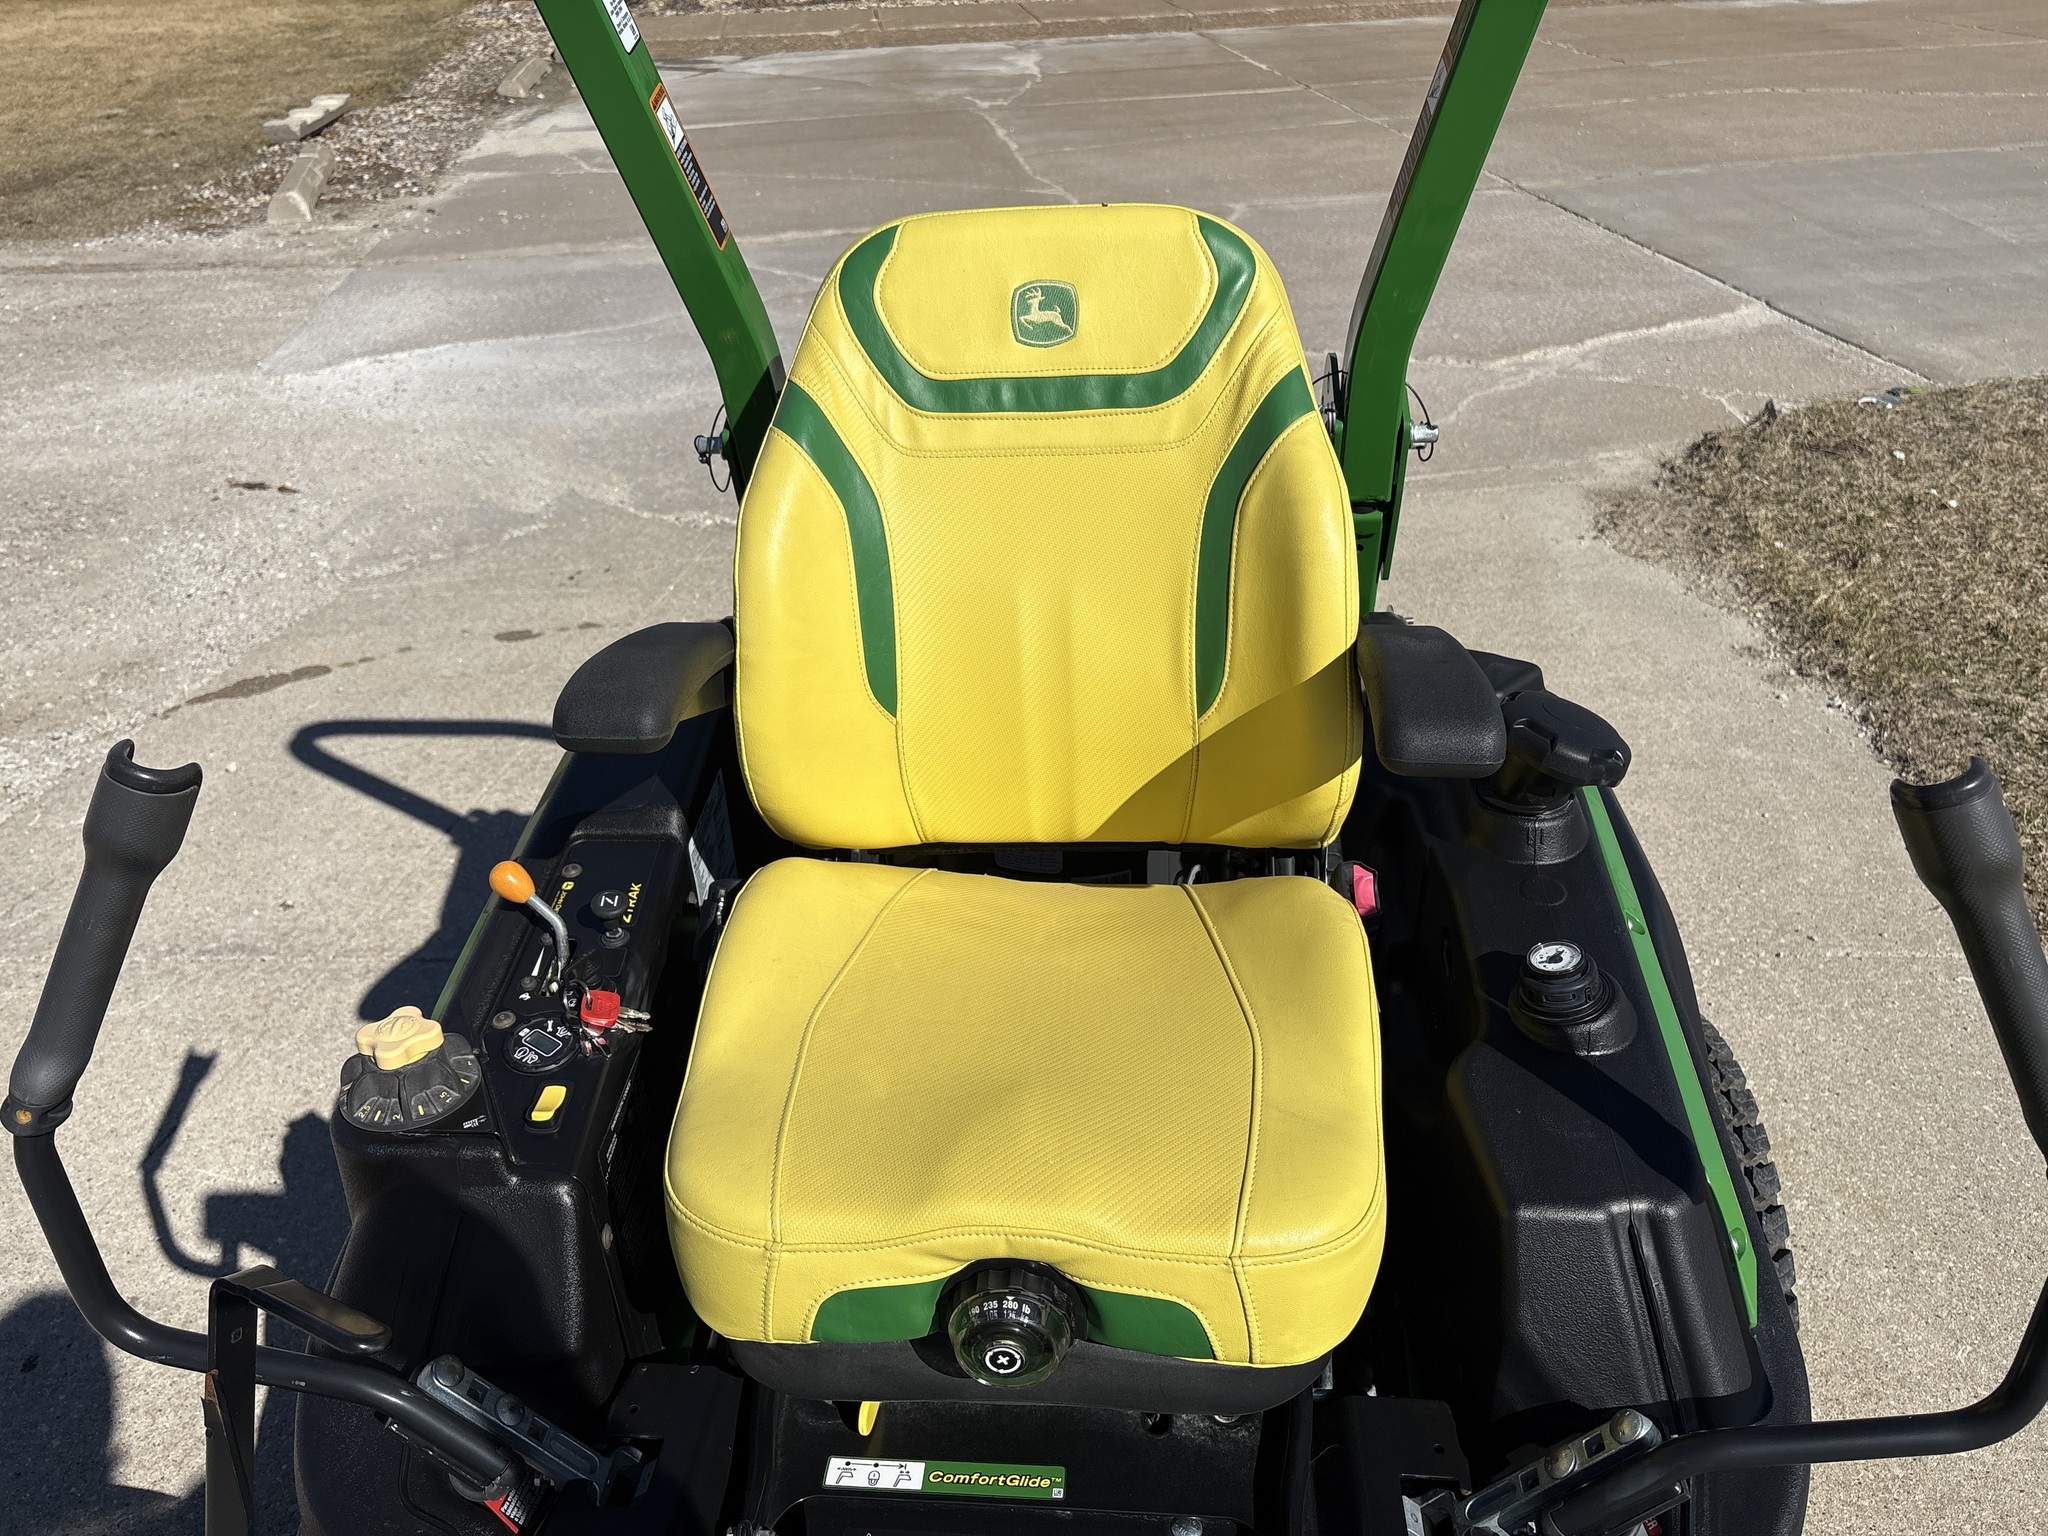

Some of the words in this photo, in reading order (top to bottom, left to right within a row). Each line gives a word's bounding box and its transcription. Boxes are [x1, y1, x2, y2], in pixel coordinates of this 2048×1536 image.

[439, 1091, 452, 1104] 1.5
[358, 1104, 371, 1119] 2.5
[392, 1112, 401, 1121] 2
[983, 1300, 998, 1311] 235
[1002, 1300, 1019, 1310] 280
[1022, 1303, 1031, 1315] lb
